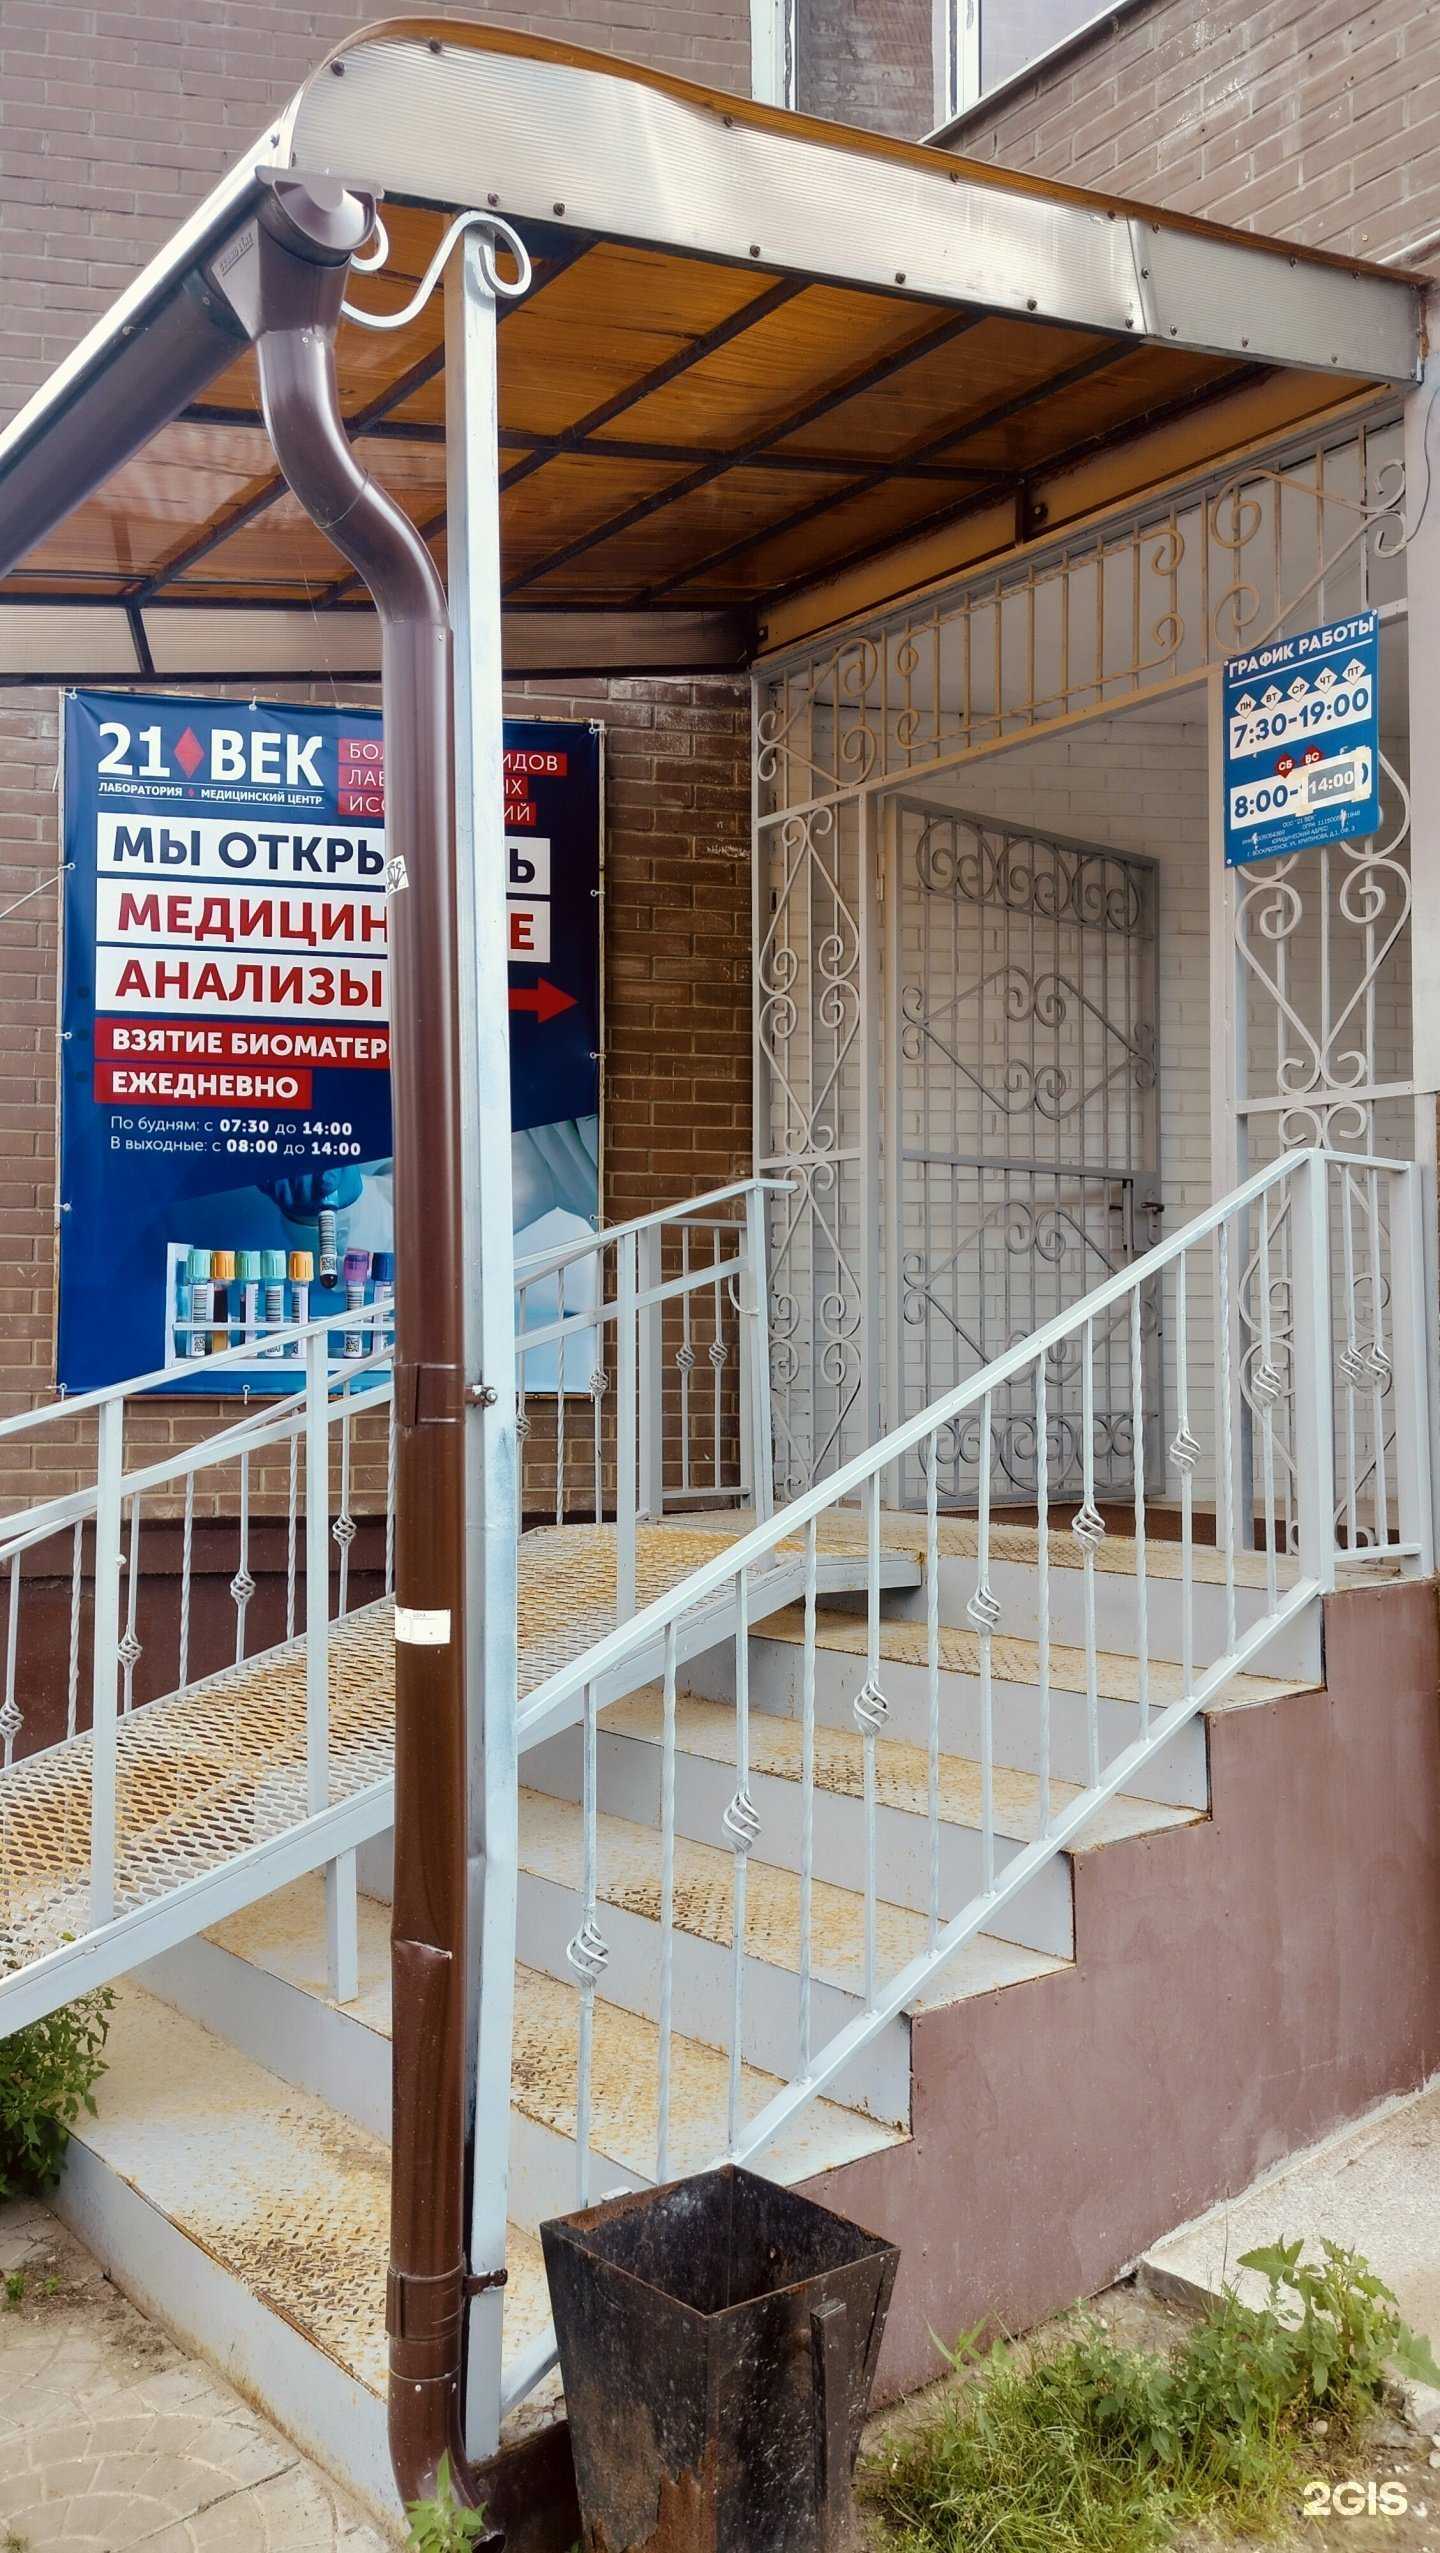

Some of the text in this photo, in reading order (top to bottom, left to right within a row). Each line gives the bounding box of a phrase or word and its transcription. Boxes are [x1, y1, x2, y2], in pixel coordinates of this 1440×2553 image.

[1229, 616, 1374, 678] ГРАФИК РАБОТЫ
[1240, 665, 1360, 712] ПН ВТ СР ЧТ ПТ
[1233, 687, 1369, 749] 7:30-19:00
[98, 723, 324, 786] 21 ВЕК
[1278, 752, 1320, 771] СБ ВС
[99, 782, 323, 806] ЛАБОРАТОРИЯ МЕДИЦИНСКИЙ ЦЕНТР
[113, 825, 199, 867] МЫ
[115, 959, 383, 1008] АНАЛИЗЫ
[112, 1029, 388, 1060] ВЗЯТИЕ БИОМАТЕР
[112, 1070, 299, 1099] ЕЖЕДНЕВНО
[111, 1116, 352, 1136] По будням: с 07:30 до 14:00
[111, 1136, 361, 1156] В выходные: с 08:00 до 14:00
